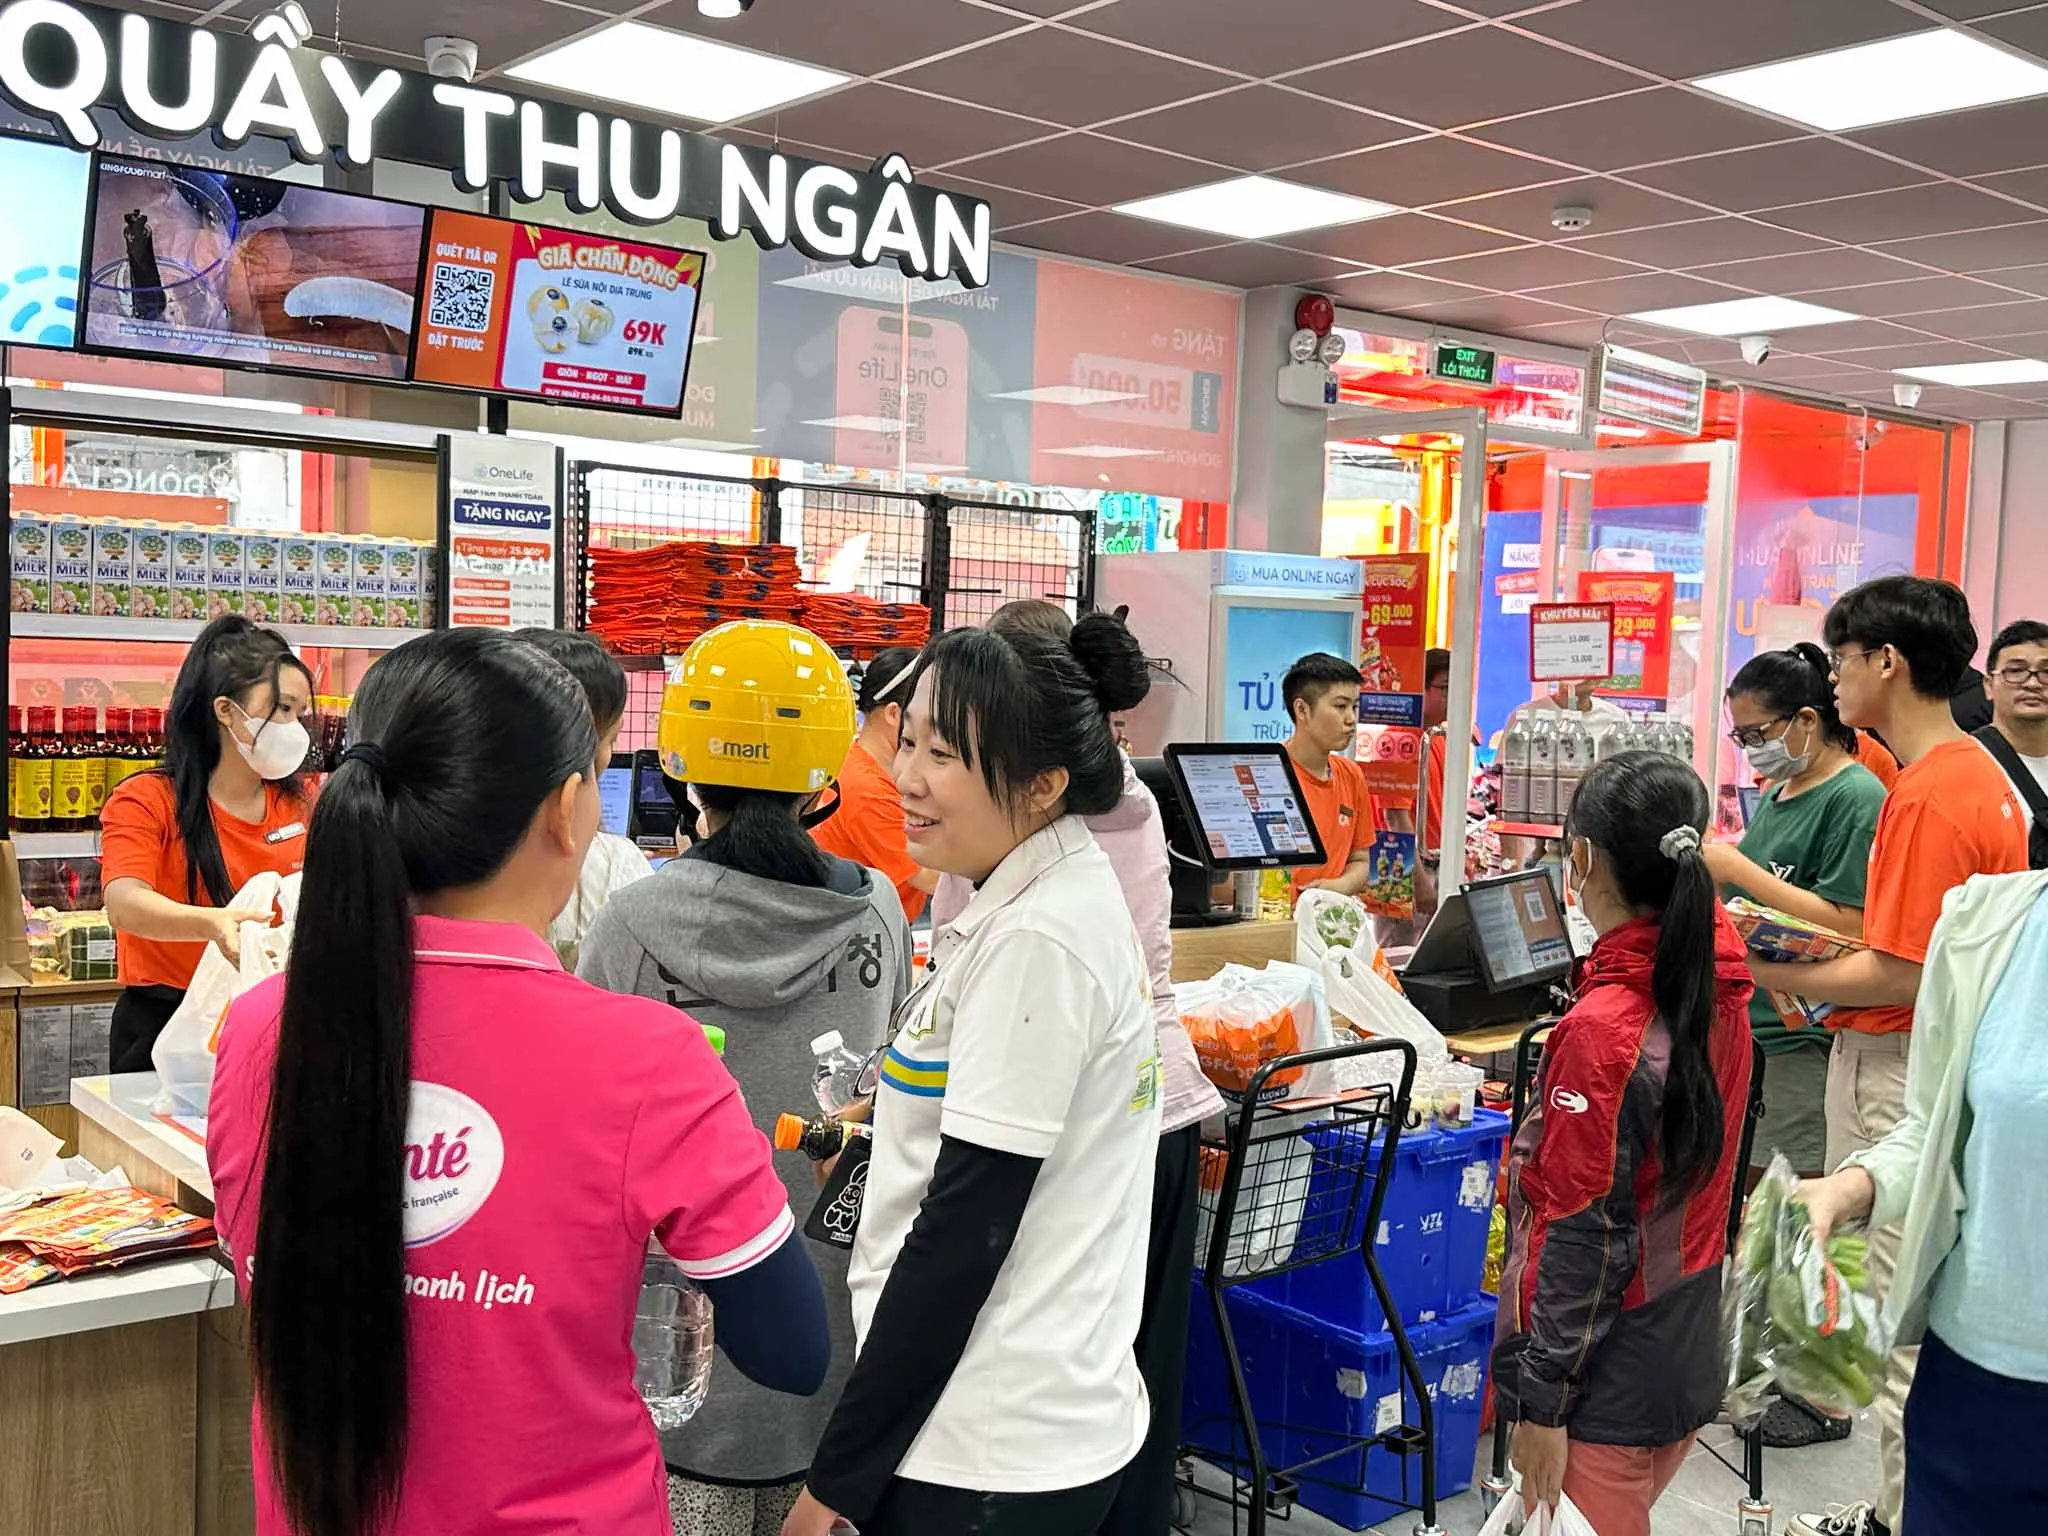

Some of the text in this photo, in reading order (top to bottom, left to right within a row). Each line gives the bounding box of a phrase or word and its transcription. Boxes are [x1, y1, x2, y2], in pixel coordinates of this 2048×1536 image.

[0, 3, 990, 286] QUẦY THU NGÂN
[436, 243, 465, 260] QUÉT
[482, 251, 498, 265] QR
[538, 240, 679, 290] GIÁ CHẤN ĐỘNG
[625, 286, 653, 301] TRUNG
[427, 332, 450, 349] ĐẶT
[622, 319, 668, 346] 69K
[1456, 349, 1477, 362] EXIT
[489, 466, 534, 481] OneLife
[462, 502, 544, 524] TẶNG NGAY
[14, 562, 47, 573] MILK
[56, 565, 88, 576] MILK
[97, 567, 129, 578] MILK
[137, 569, 167, 580] MILK
[175, 571, 205, 582] MILK
[211, 574, 241, 585] MILK
[248, 576, 278, 586] MILK
[285, 577, 314, 588] MILK
[1251, 567, 1356, 585] MUA ONLINE NGAY
[320, 579, 349, 590] MILK
[356, 580, 384, 592] MILK
[390, 583, 417, 593] MILK
[1371, 604, 1413, 625] 69.000
[1238, 672, 1274, 711] TỦ
[1253, 721, 1280, 741] TRỮ
[708, 737, 770, 759] emart
[403, 1126, 473, 1181] nté
[411, 1186, 460, 1208] française
[474, 1269, 535, 1310] lịch
